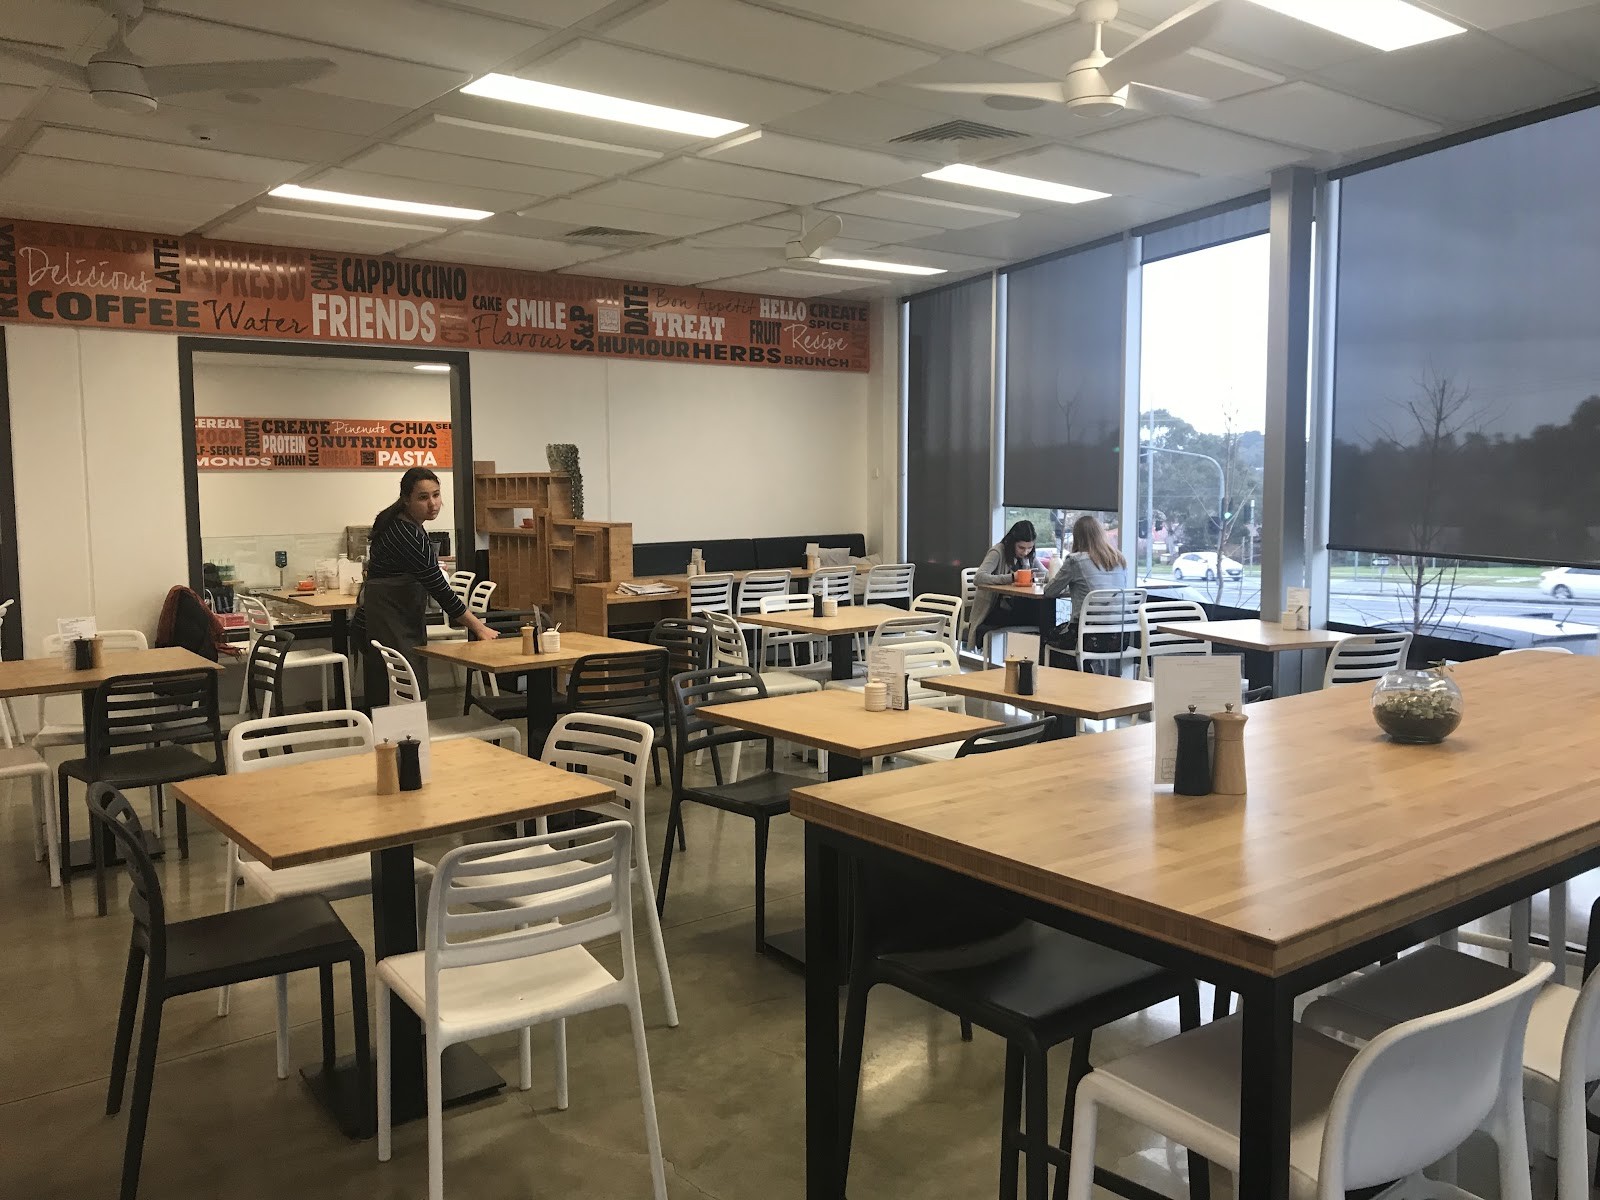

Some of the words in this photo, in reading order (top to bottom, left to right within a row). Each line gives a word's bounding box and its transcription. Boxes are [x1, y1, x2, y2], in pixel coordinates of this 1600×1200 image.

[19, 246, 152, 292] Delicious
[153, 239, 181, 293] LATTE
[184, 241, 305, 301] ESPRESSO
[342, 258, 467, 301] CAPPUCCINO
[28, 290, 201, 328] COFFEE
[473, 295, 502, 311] CAKE
[624, 285, 648, 335] DATE
[652, 287, 690, 308] Bon
[760, 298, 807, 321] HELLO
[203, 299, 309, 333] Water
[312, 293, 436, 342] FRIENDS
[507, 298, 566, 330] SMILE
[809, 303, 867, 321] CREATE
[472, 314, 568, 349] Flavour
[570, 305, 594, 352] S&P
[652, 312, 725, 341] TREAT
[750, 320, 782, 346] FRUIT
[809, 320, 849, 331] SPICE
[598, 335, 690, 358] HUMOUR
[784, 323, 848, 357] Recipe
[693, 343, 782, 364] HERBS
[784, 355, 848, 368] BRUNCH
[244, 419, 260, 457] FRUIT
[261, 420, 330, 435] CREATE
[332, 421, 387, 434] Pinenuts
[390, 422, 436, 434] CHIA
[262, 435, 306, 454] PROTEIN
[308, 436, 319, 467] KILO
[320, 436, 438, 448] NUTRITIOUS
[273, 455, 306, 466] TAHINI
[378, 451, 438, 467] PASTA
